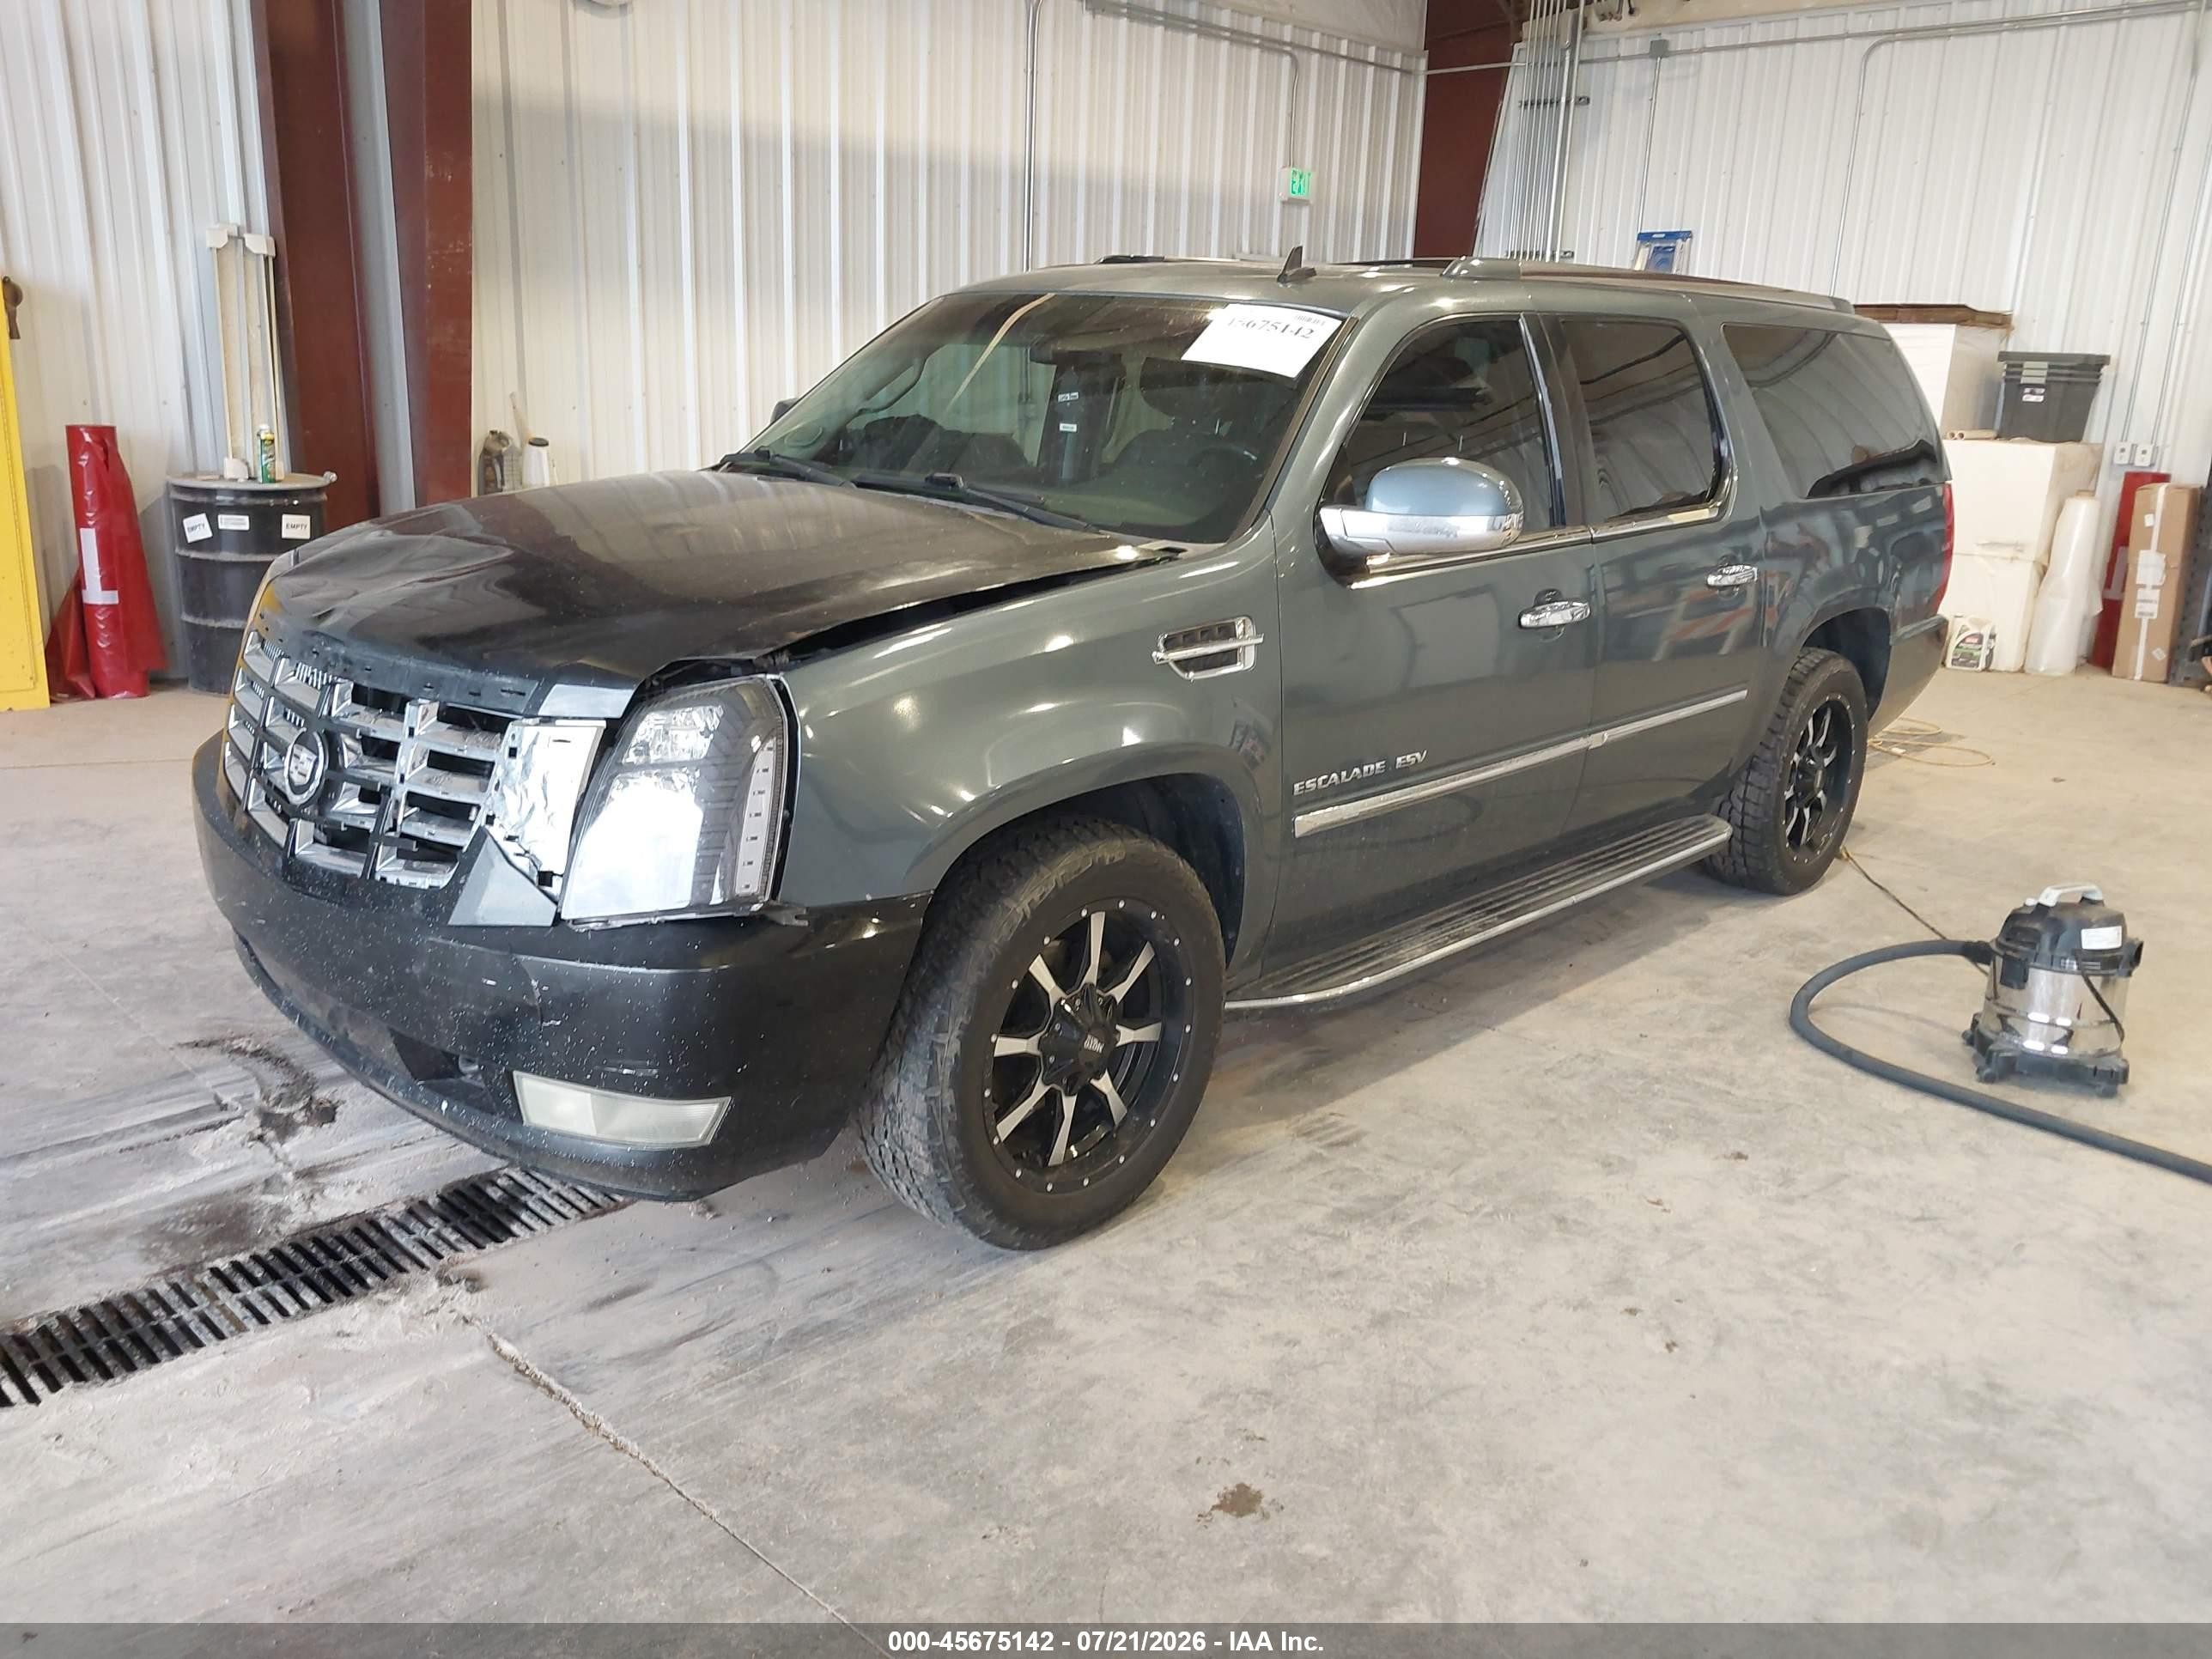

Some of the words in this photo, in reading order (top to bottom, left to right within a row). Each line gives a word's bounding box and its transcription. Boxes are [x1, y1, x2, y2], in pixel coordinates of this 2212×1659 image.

[1291, 169, 1311, 196] EXIT
[285, 521, 307, 531] EMPTY
[1292, 760, 1386, 796] ESCALADE
[1395, 749, 1428, 769] ESV
